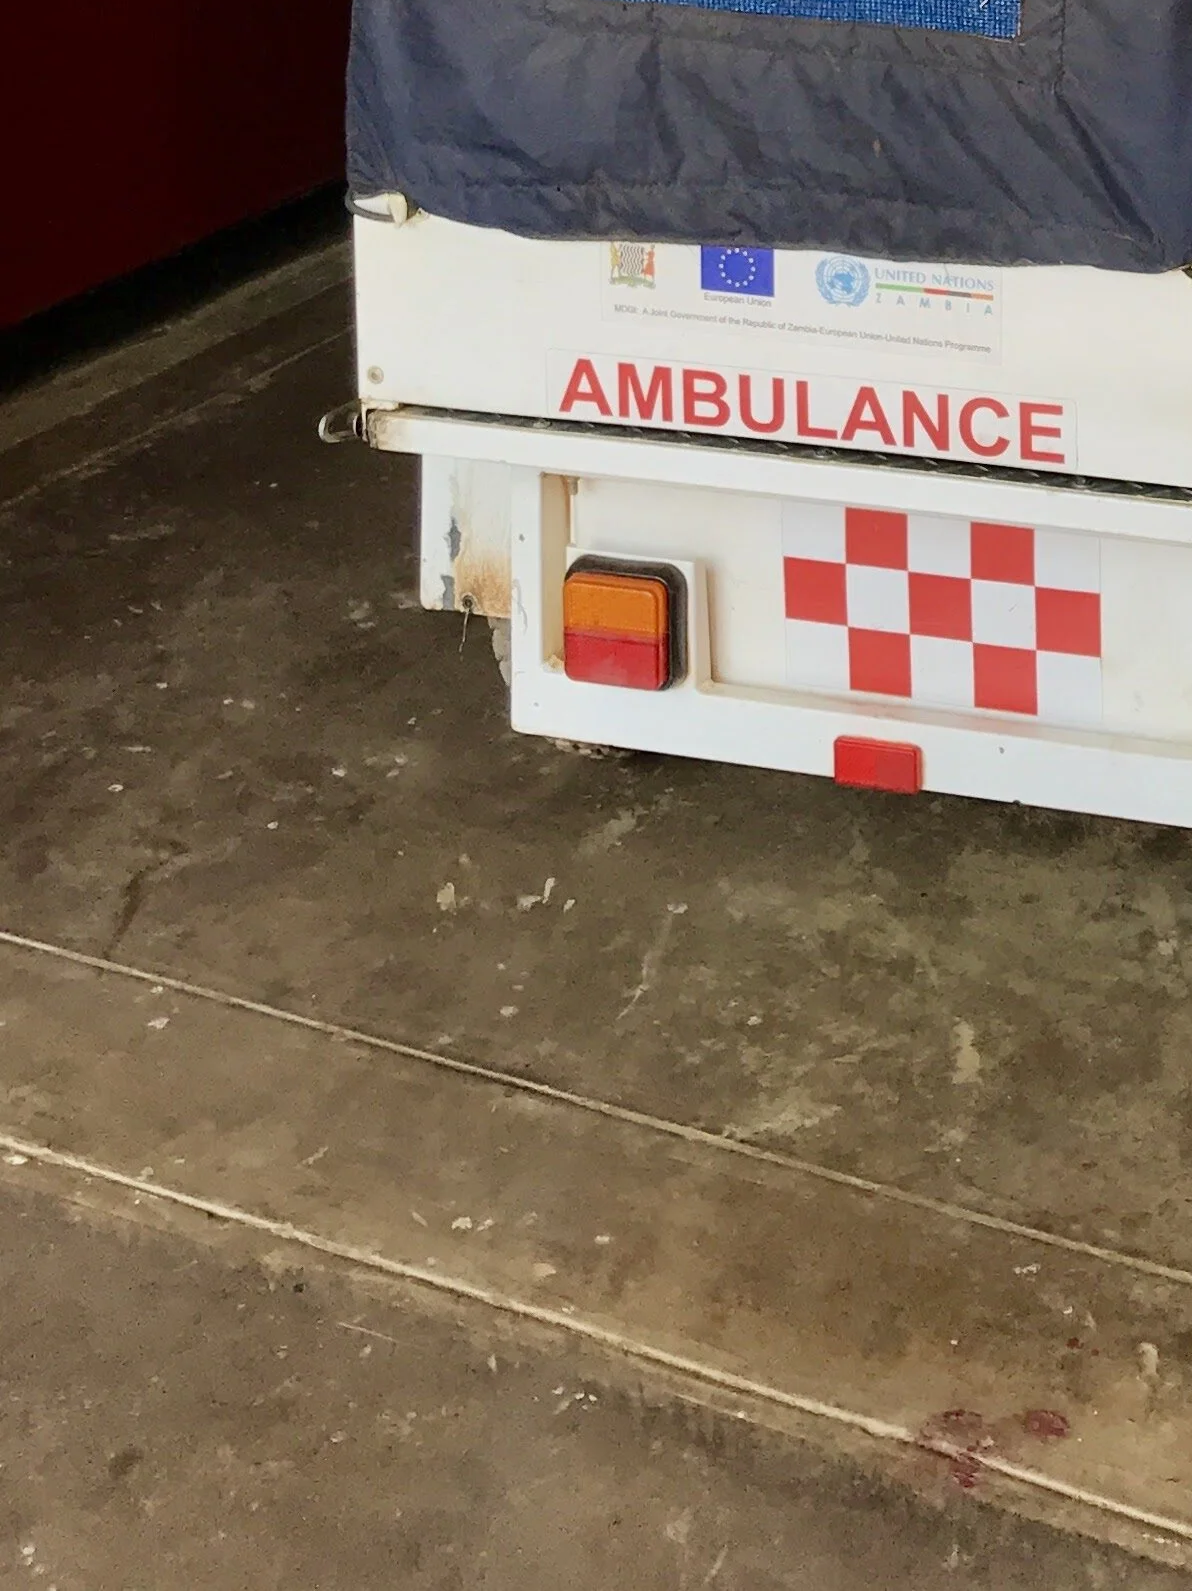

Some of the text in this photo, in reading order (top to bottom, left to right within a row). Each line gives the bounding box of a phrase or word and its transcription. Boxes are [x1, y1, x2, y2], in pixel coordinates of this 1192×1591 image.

[874, 267, 994, 291] UNITED NATIONS
[704, 292, 772, 307] European Union
[670, 310, 717, 323] Government
[728, 316, 740, 325] the
[742, 318, 776, 330] Republic
[913, 336, 943, 348] Nations
[945, 340, 991, 354] Programme
[558, 357, 1066, 465] AMBULANCE
